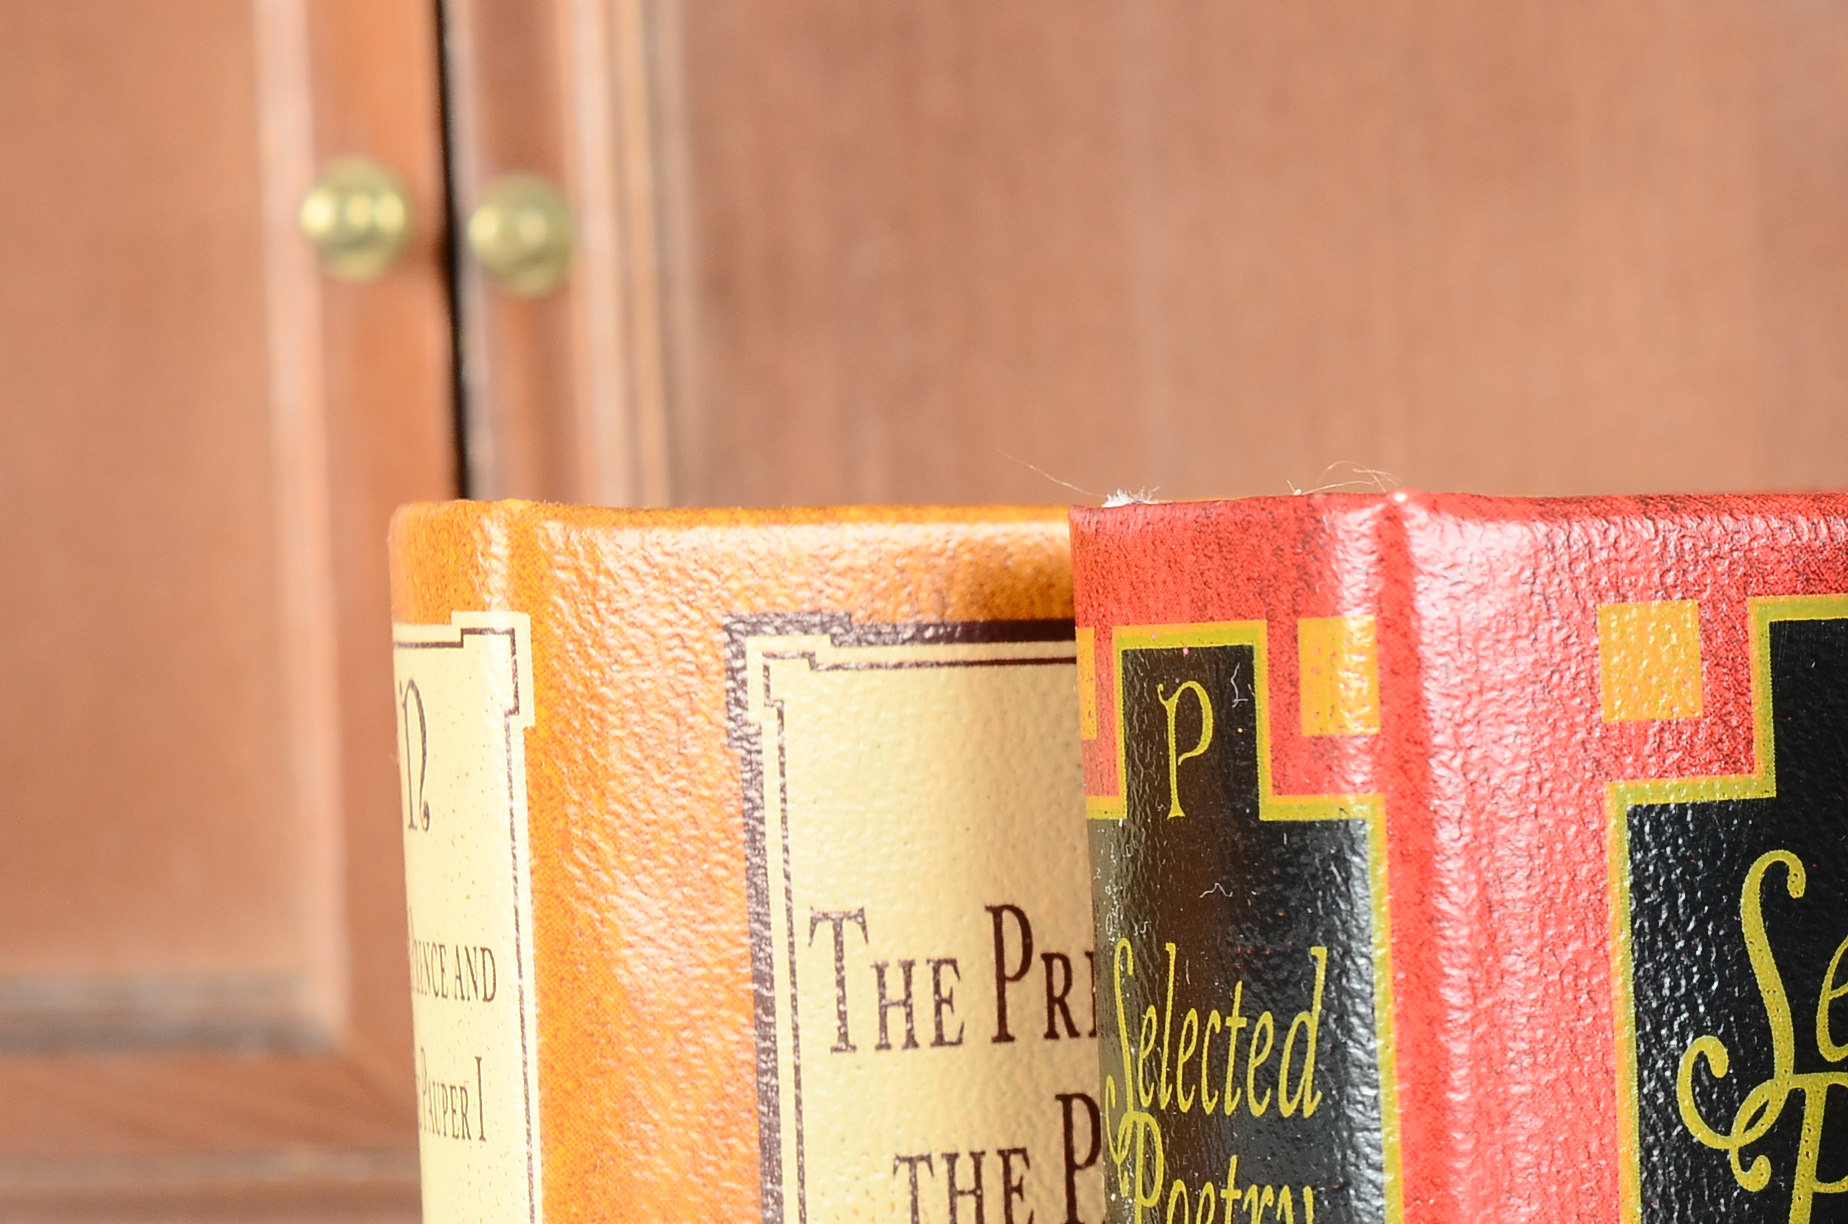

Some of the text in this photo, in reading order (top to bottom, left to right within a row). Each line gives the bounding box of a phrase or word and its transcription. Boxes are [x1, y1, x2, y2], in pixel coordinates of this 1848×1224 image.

[1157, 680, 1214, 820] P
[454, 944, 497, 1003] AND
[1105, 937, 1328, 1198] Selected
